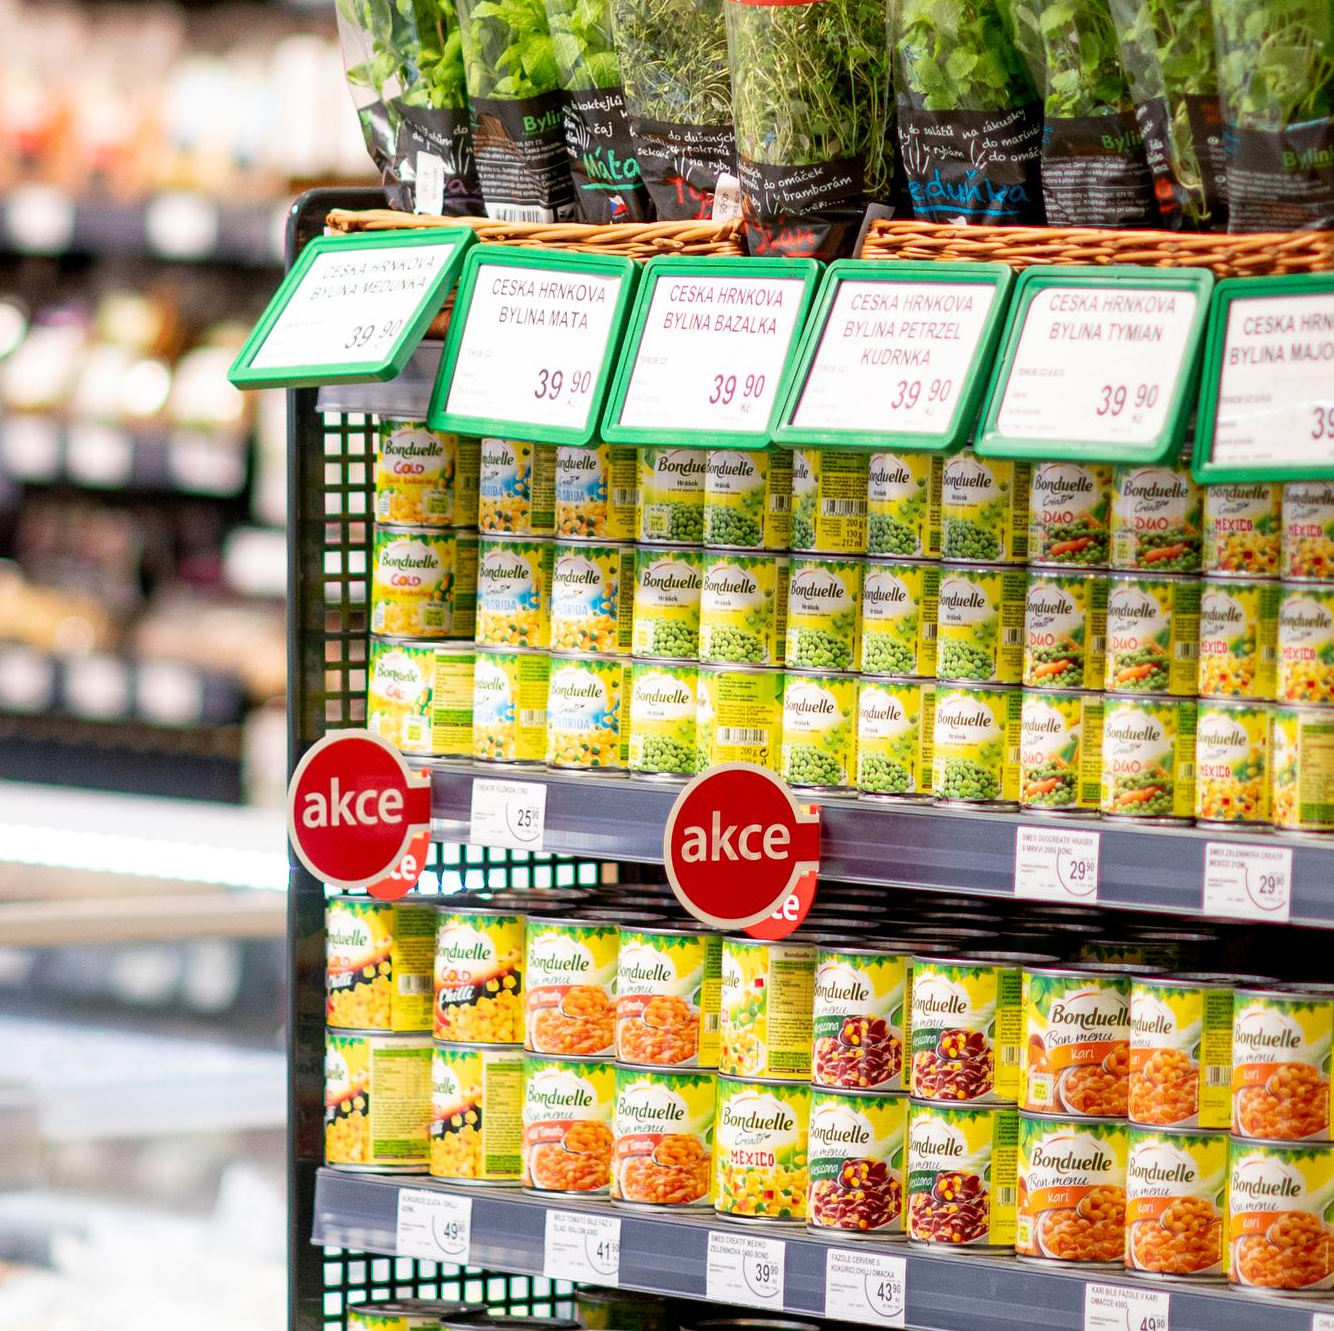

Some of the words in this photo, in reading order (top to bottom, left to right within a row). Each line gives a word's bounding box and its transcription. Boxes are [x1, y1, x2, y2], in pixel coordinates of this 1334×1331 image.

[593, 122, 613, 138] čaj
[961, 128, 979, 140] na
[982, 109, 1027, 134] zákusky
[668, 129, 681, 142] do
[982, 136, 999, 150] do
[689, 157, 705, 169] na
[707, 159, 732, 176] ryby
[988, 150, 1007, 163] do
[763, 178, 776, 191] do
[782, 176, 853, 202] bramborám
[492, 277, 536, 299] CESKA
[538, 281, 607, 304] HRNKOVA
[669, 284, 715, 304] CESKA
[717, 286, 785, 308] HRNKOVA
[851, 292, 899, 312] CESKA
[902, 293, 975, 313] HRNKOVA
[1048, 293, 1099, 313] CESKA
[1103, 293, 1178, 315] HRNKOVA
[498, 305, 546, 327] BYLINA
[548, 309, 589, 331] MATA
[663, 311, 712, 332] BYLINA
[714, 314, 778, 336] BAZALKA
[1243, 315, 1296, 336] CESKA
[344, 324, 376, 350] 39
[378, 318, 404, 340] 90
[842, 320, 896, 340] BYLINA
[899, 321, 964, 341] PETRZEL
[1048, 321, 1103, 342] BYLINA
[1108, 322, 1165, 343] TYMIAN
[860, 347, 932, 367] KUDRNKA
[1229, 343, 1285, 367] BYLINA
[534, 367, 565, 401] 39
[569, 370, 593, 395] 90
[709, 373, 738, 406] 39
[742, 373, 766, 399] 90
[890, 379, 923, 411] 39
[927, 378, 953, 403] 90
[1095, 383, 1129, 418] 39
[1133, 382, 1160, 410] 90
[384, 439, 444, 459] Bonduelle
[393, 461, 425, 475] GOLD
[1034, 474, 1094, 493] Bonduelle
[1123, 480, 1189, 499] Bonduelle
[1042, 509, 1074, 524] DUO
[1134, 516, 1169, 531] DUO
[1215, 517, 1253, 532] MEXICO
[381, 551, 439, 570] Bonduelle
[642, 570, 703, 591] Bonduelle
[705, 575, 757, 595] Bonduelle
[790, 580, 844, 599] Bonduelle
[634, 687, 690, 706] Bonduelle
[937, 710, 992, 730] Bonduelle
[302, 776, 406, 829] akce
[680, 810, 793, 864] akce
[1069, 859, 1086, 881] 29
[1258, 874, 1276, 895] 29
[529, 953, 590, 977] Bonduelle
[1072, 1031, 1116, 1045] menu
[1234, 1026, 1302, 1050] Bonduelle
[1070, 1043, 1095, 1060] kari
[527, 1087, 593, 1110] Bonduelle
[618, 1099, 685, 1123] Bonduelle
[722, 1107, 794, 1134] Bonduelle
[810, 1119, 870, 1148] Bonduelle
[730, 1150, 775, 1168] MEXICO
[1031, 1147, 1113, 1175] Bonduelle
[1052, 1176, 1091, 1189] menu
[1128, 1160, 1195, 1184] Bonduelle
[1046, 1188, 1071, 1205] kari
[1232, 1174, 1302, 1199] Bonduelle
[443, 1221, 458, 1242] 49
[755, 1263, 771, 1283] 39
[877, 1282, 893, 1302] 43
